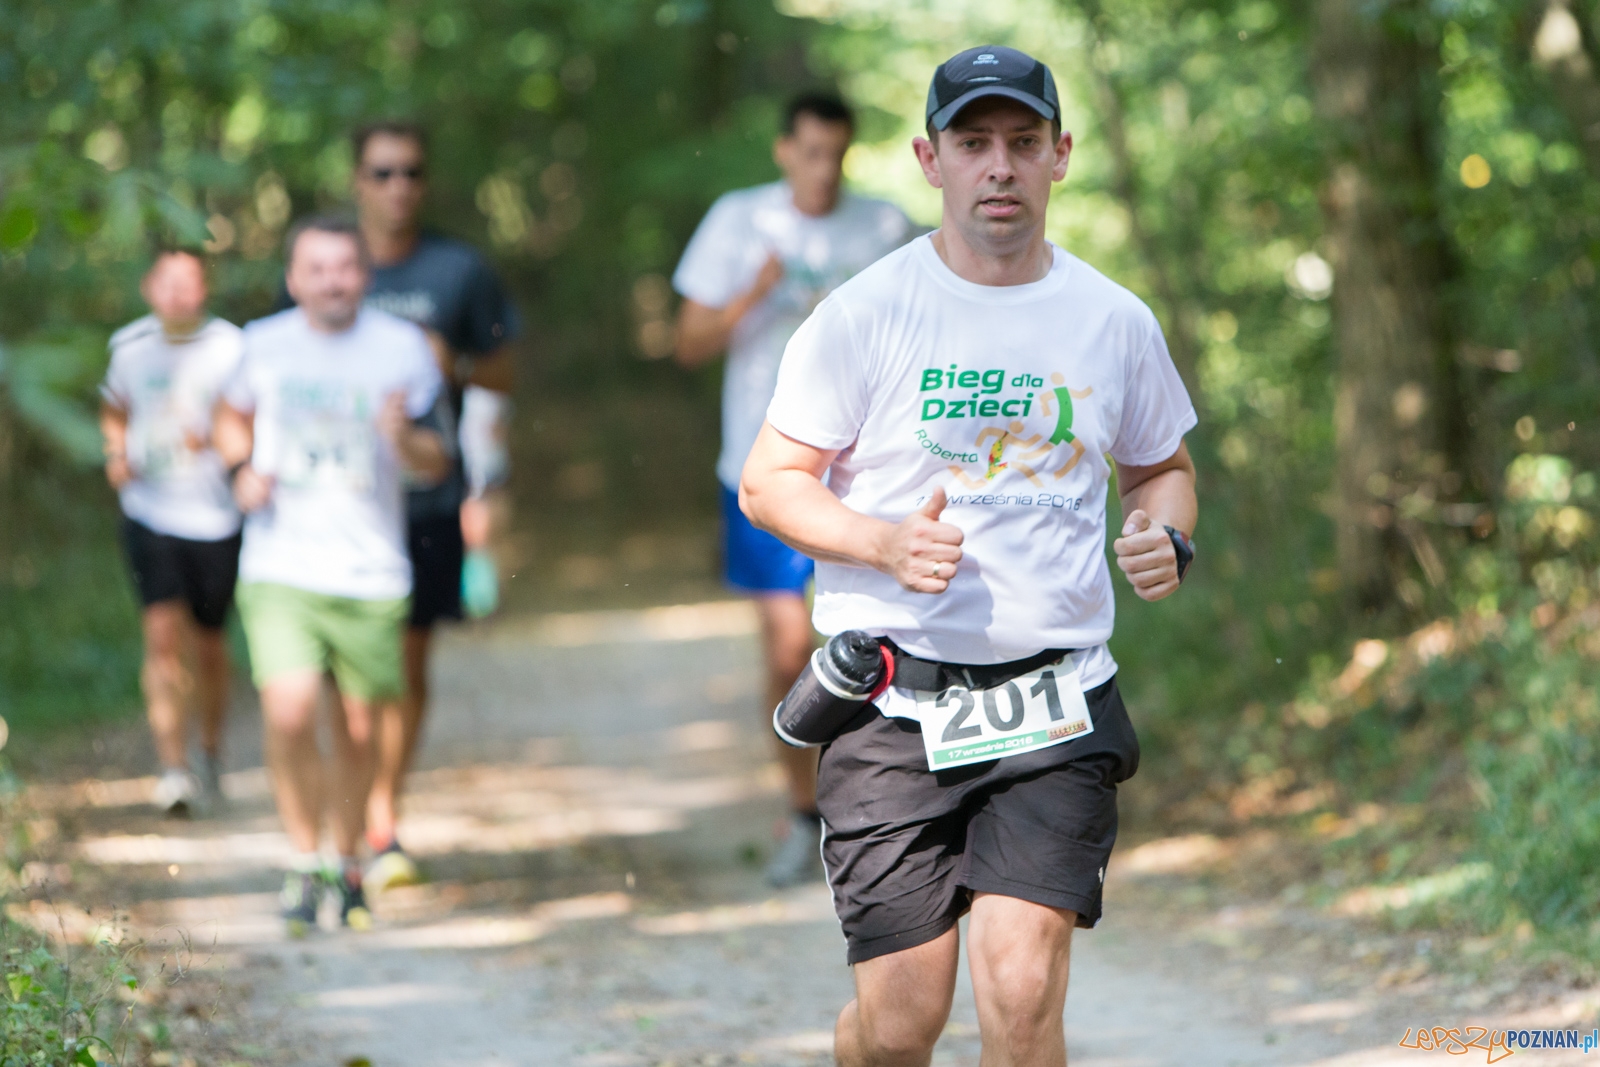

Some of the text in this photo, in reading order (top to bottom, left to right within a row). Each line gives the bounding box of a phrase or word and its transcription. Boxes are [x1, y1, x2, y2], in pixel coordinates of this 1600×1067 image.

[919, 364, 1043, 394] Bieg dla
[921, 393, 1034, 421] Dzieci
[914, 428, 978, 463] Roberta
[946, 492, 1033, 506] września
[1036, 493, 1083, 511] 2016
[935, 670, 1065, 743] 201
[947, 749, 963, 759] 17
[1004, 736, 1034, 749] 2016
